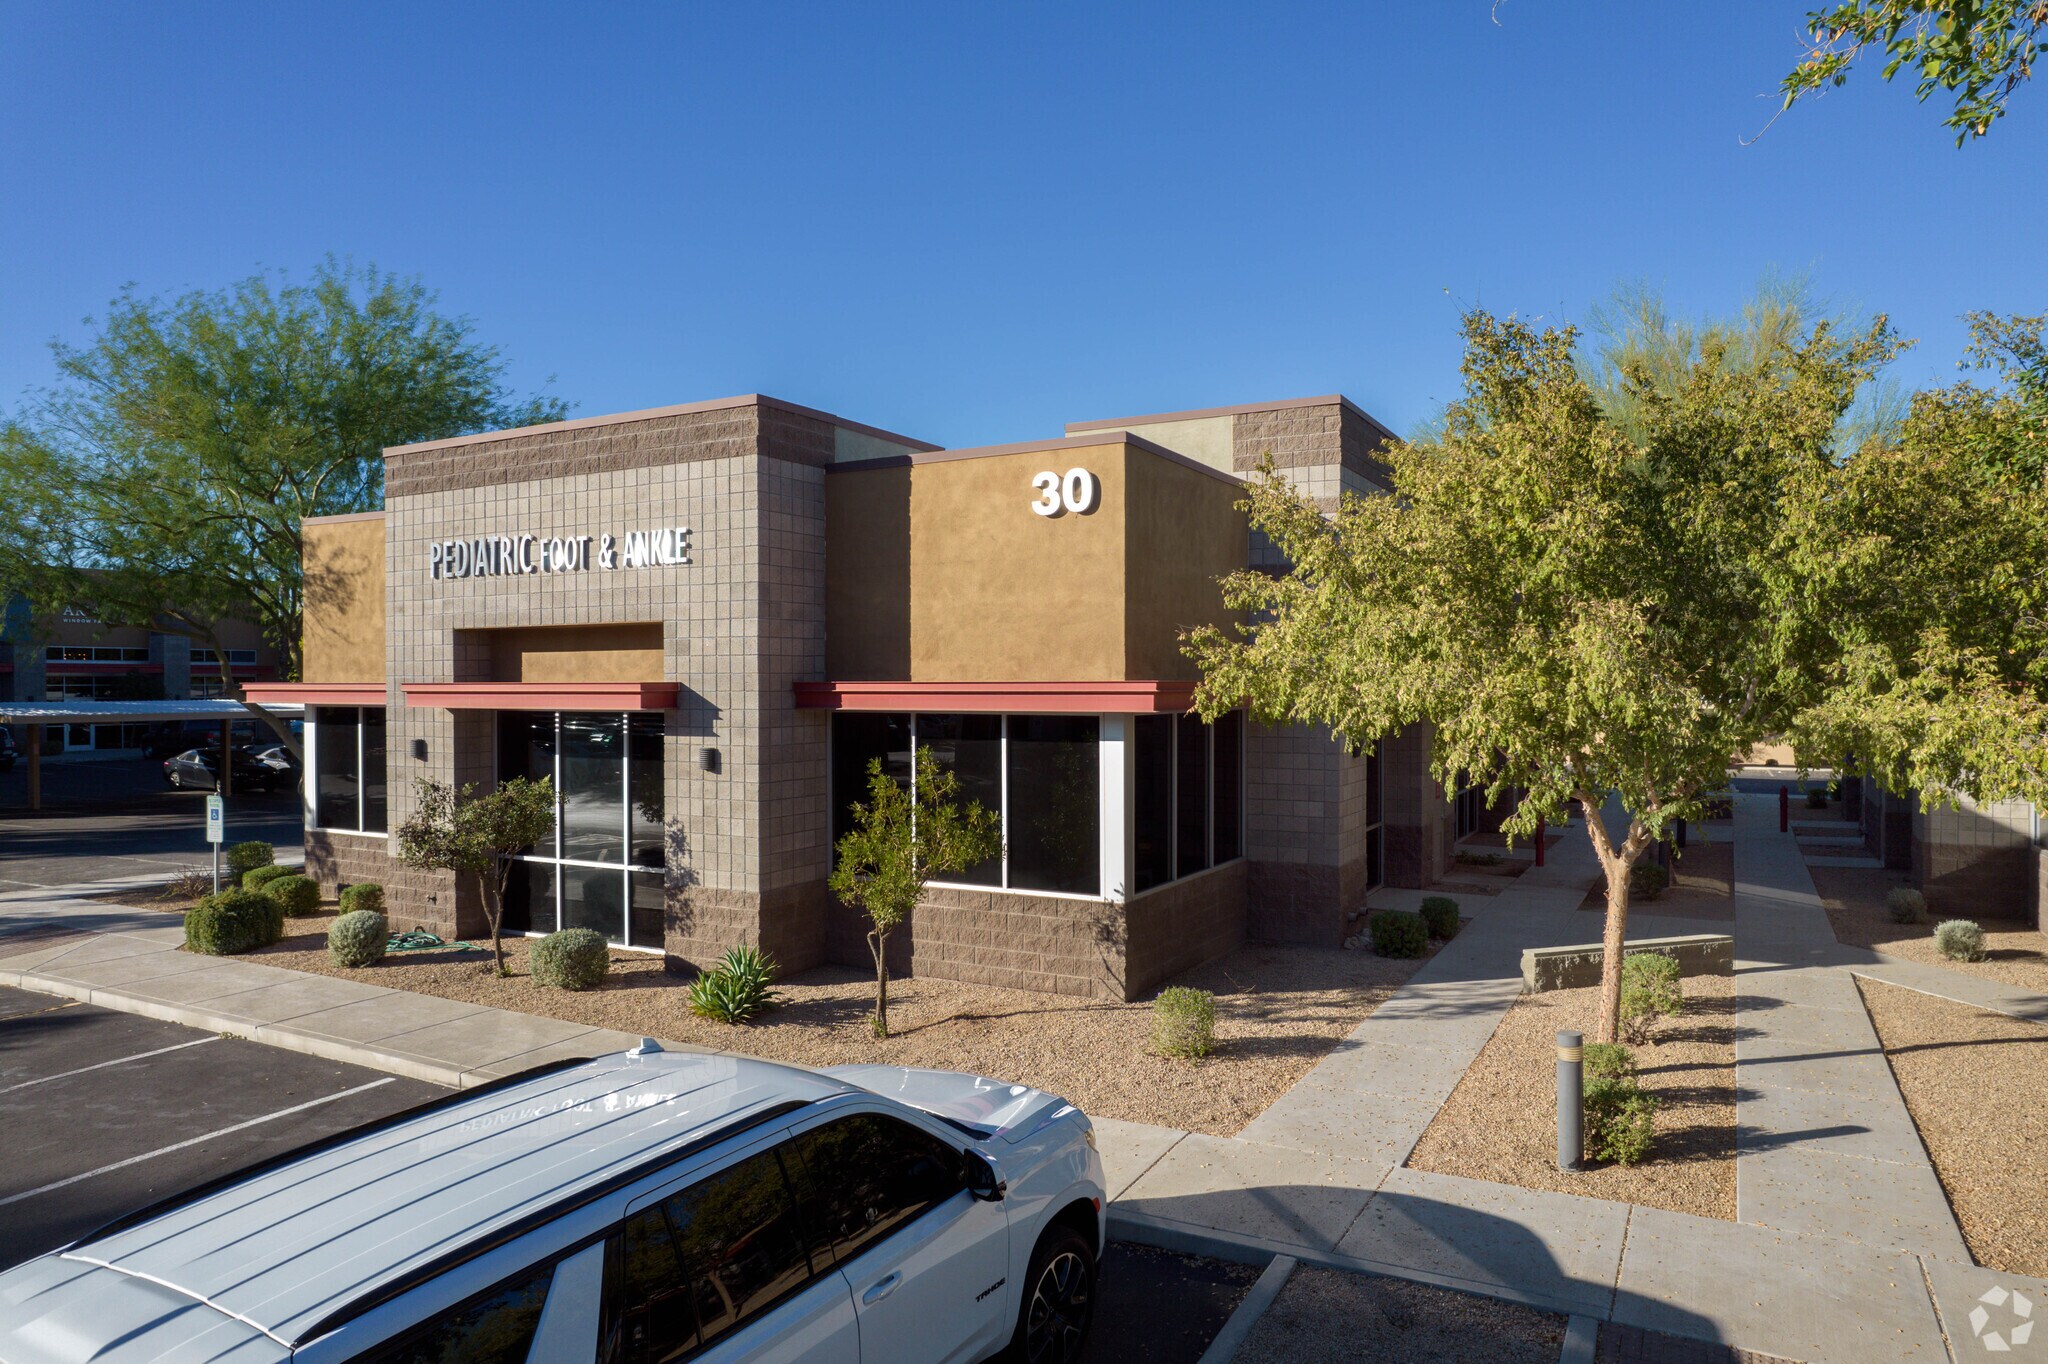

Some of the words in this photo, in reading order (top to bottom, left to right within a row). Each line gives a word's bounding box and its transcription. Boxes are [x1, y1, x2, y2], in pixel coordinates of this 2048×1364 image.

[1031, 467, 1093, 516] 30
[430, 533, 534, 579] PEDIATRIC
[540, 535, 588, 571] FOOT
[598, 533, 615, 569] &
[622, 527, 688, 567] ANKLE
[975, 1277, 1006, 1303] TAHOE
